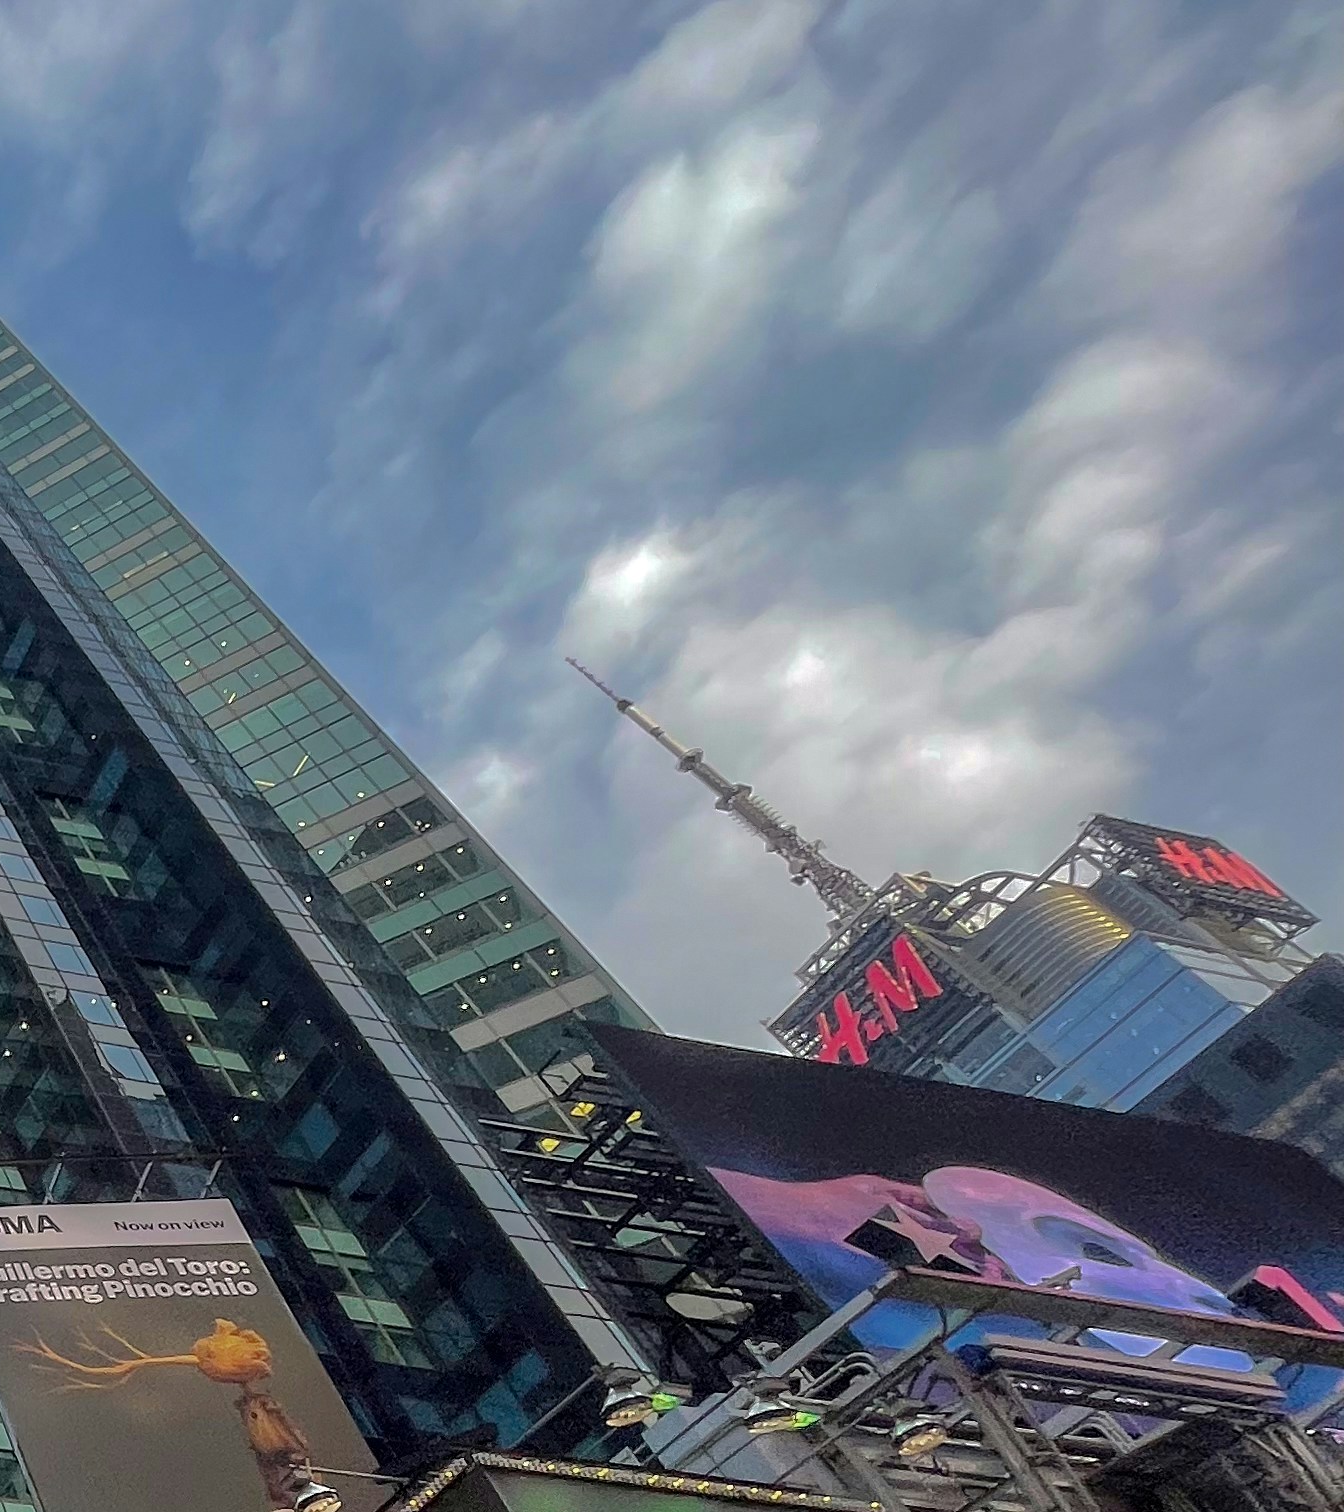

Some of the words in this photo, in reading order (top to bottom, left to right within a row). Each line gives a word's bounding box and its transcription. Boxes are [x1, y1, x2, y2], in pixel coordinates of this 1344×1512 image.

[815, 934, 943, 1066] H&M
[114, 1219, 153, 1232] Now
[159, 1221, 182, 1231] on
[184, 1218, 225, 1231] view
[121, 1258, 167, 1278] del
[168, 1257, 250, 1277] Toro:
[106, 1278, 258, 1299] Pinocchio
